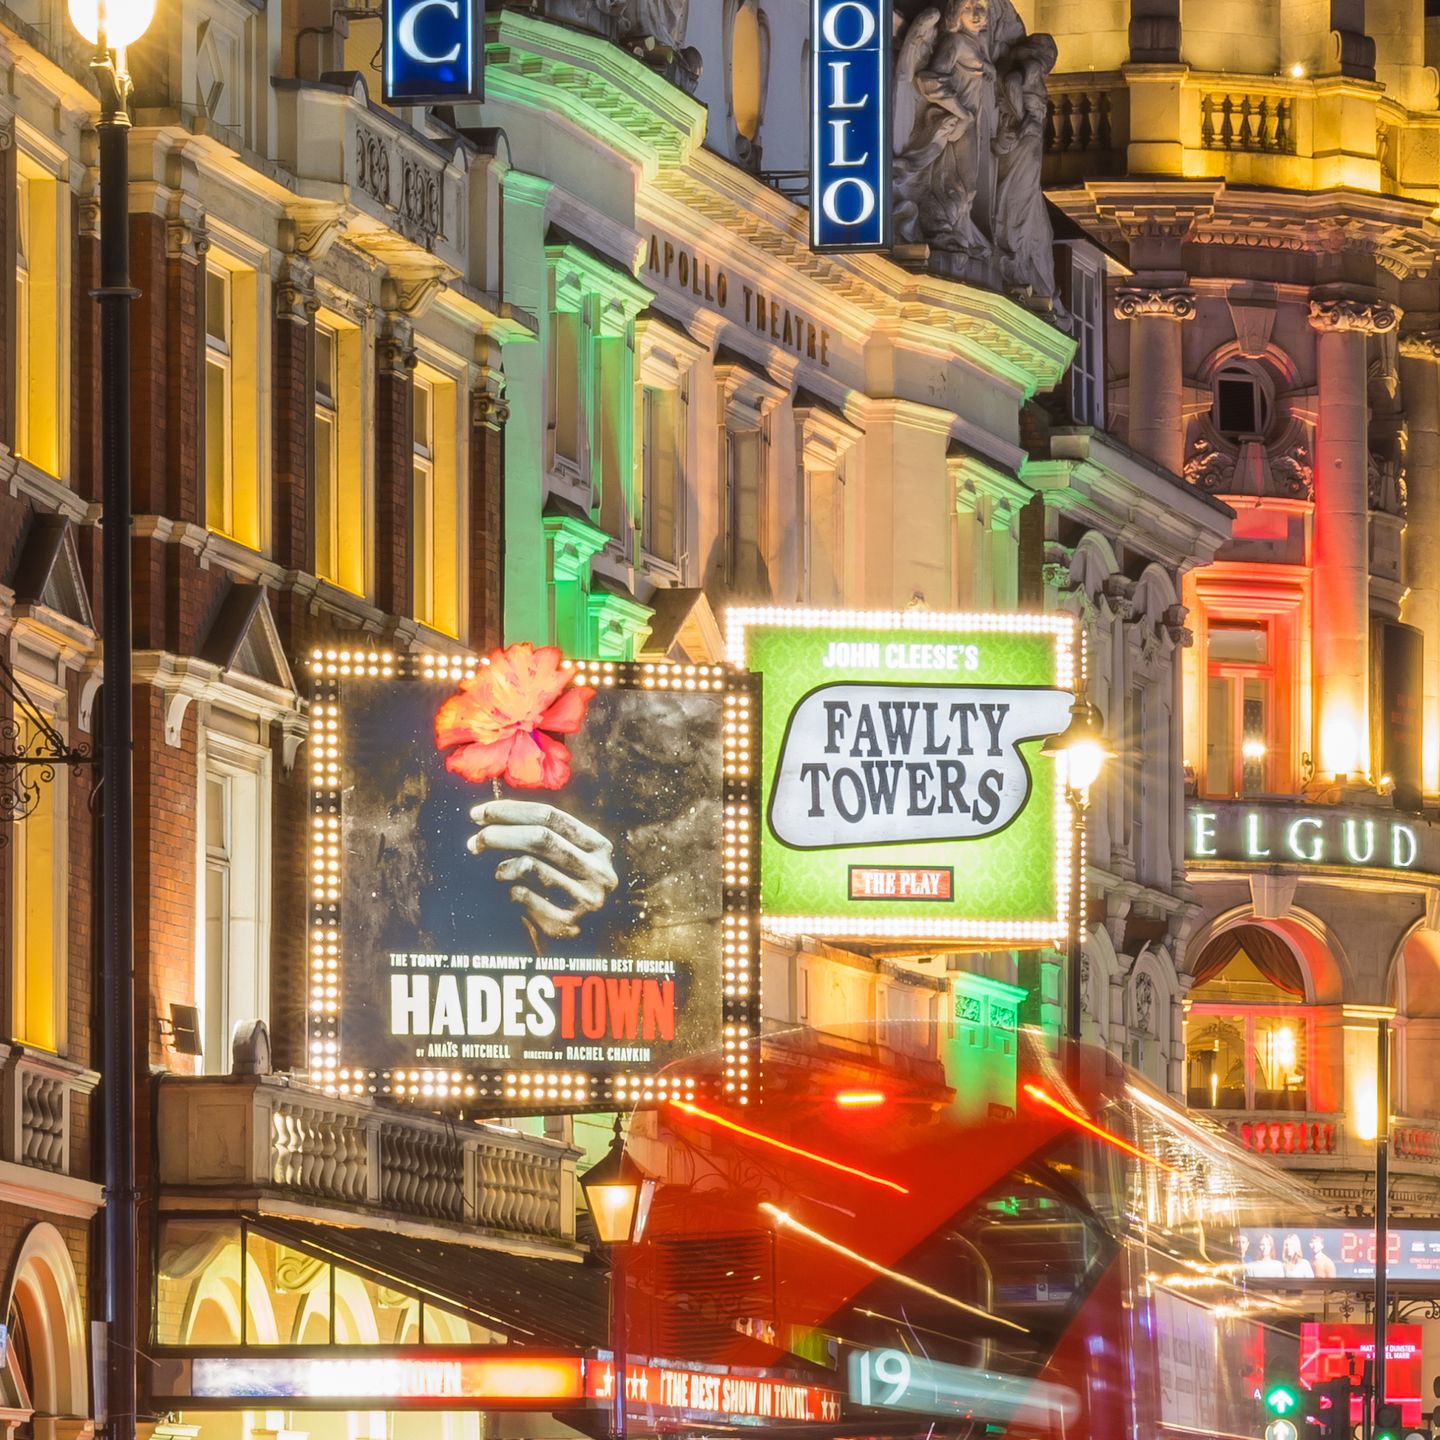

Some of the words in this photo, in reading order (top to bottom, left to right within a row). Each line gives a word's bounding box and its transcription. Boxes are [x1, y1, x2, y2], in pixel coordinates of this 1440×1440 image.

[648, 234, 727, 308] APOLLO
[742, 284, 830, 368] THEATRE
[823, 642, 879, 668] JOHN
[823, 701, 1010, 757] FAWLTY
[799, 759, 1004, 825] TOWERS
[1193, 812, 1419, 868] ELGUD
[862, 872, 896, 895] THE
[899, 873, 941, 896] PLAY
[390, 953, 407, 966] THE
[451, 956, 470, 968] AND
[536, 957, 608, 972] AWARD-WINNING
[611, 958, 633, 972] BEST
[636, 959, 675, 973] MUSICAL
[391, 974, 675, 1040] HADESTOWN
[416, 1048, 425, 1057] BY
[462, 1044, 511, 1058] MITCHELL
[566, 1047, 604, 1061] RACHEL
[607, 1048, 651, 1062] CHAVKIN
[690, 1372, 720, 1412] BEST
[722, 1377, 757, 1416] SHOW
[759, 1382, 773, 1417] IN
[860, 1349, 911, 1406] 19
